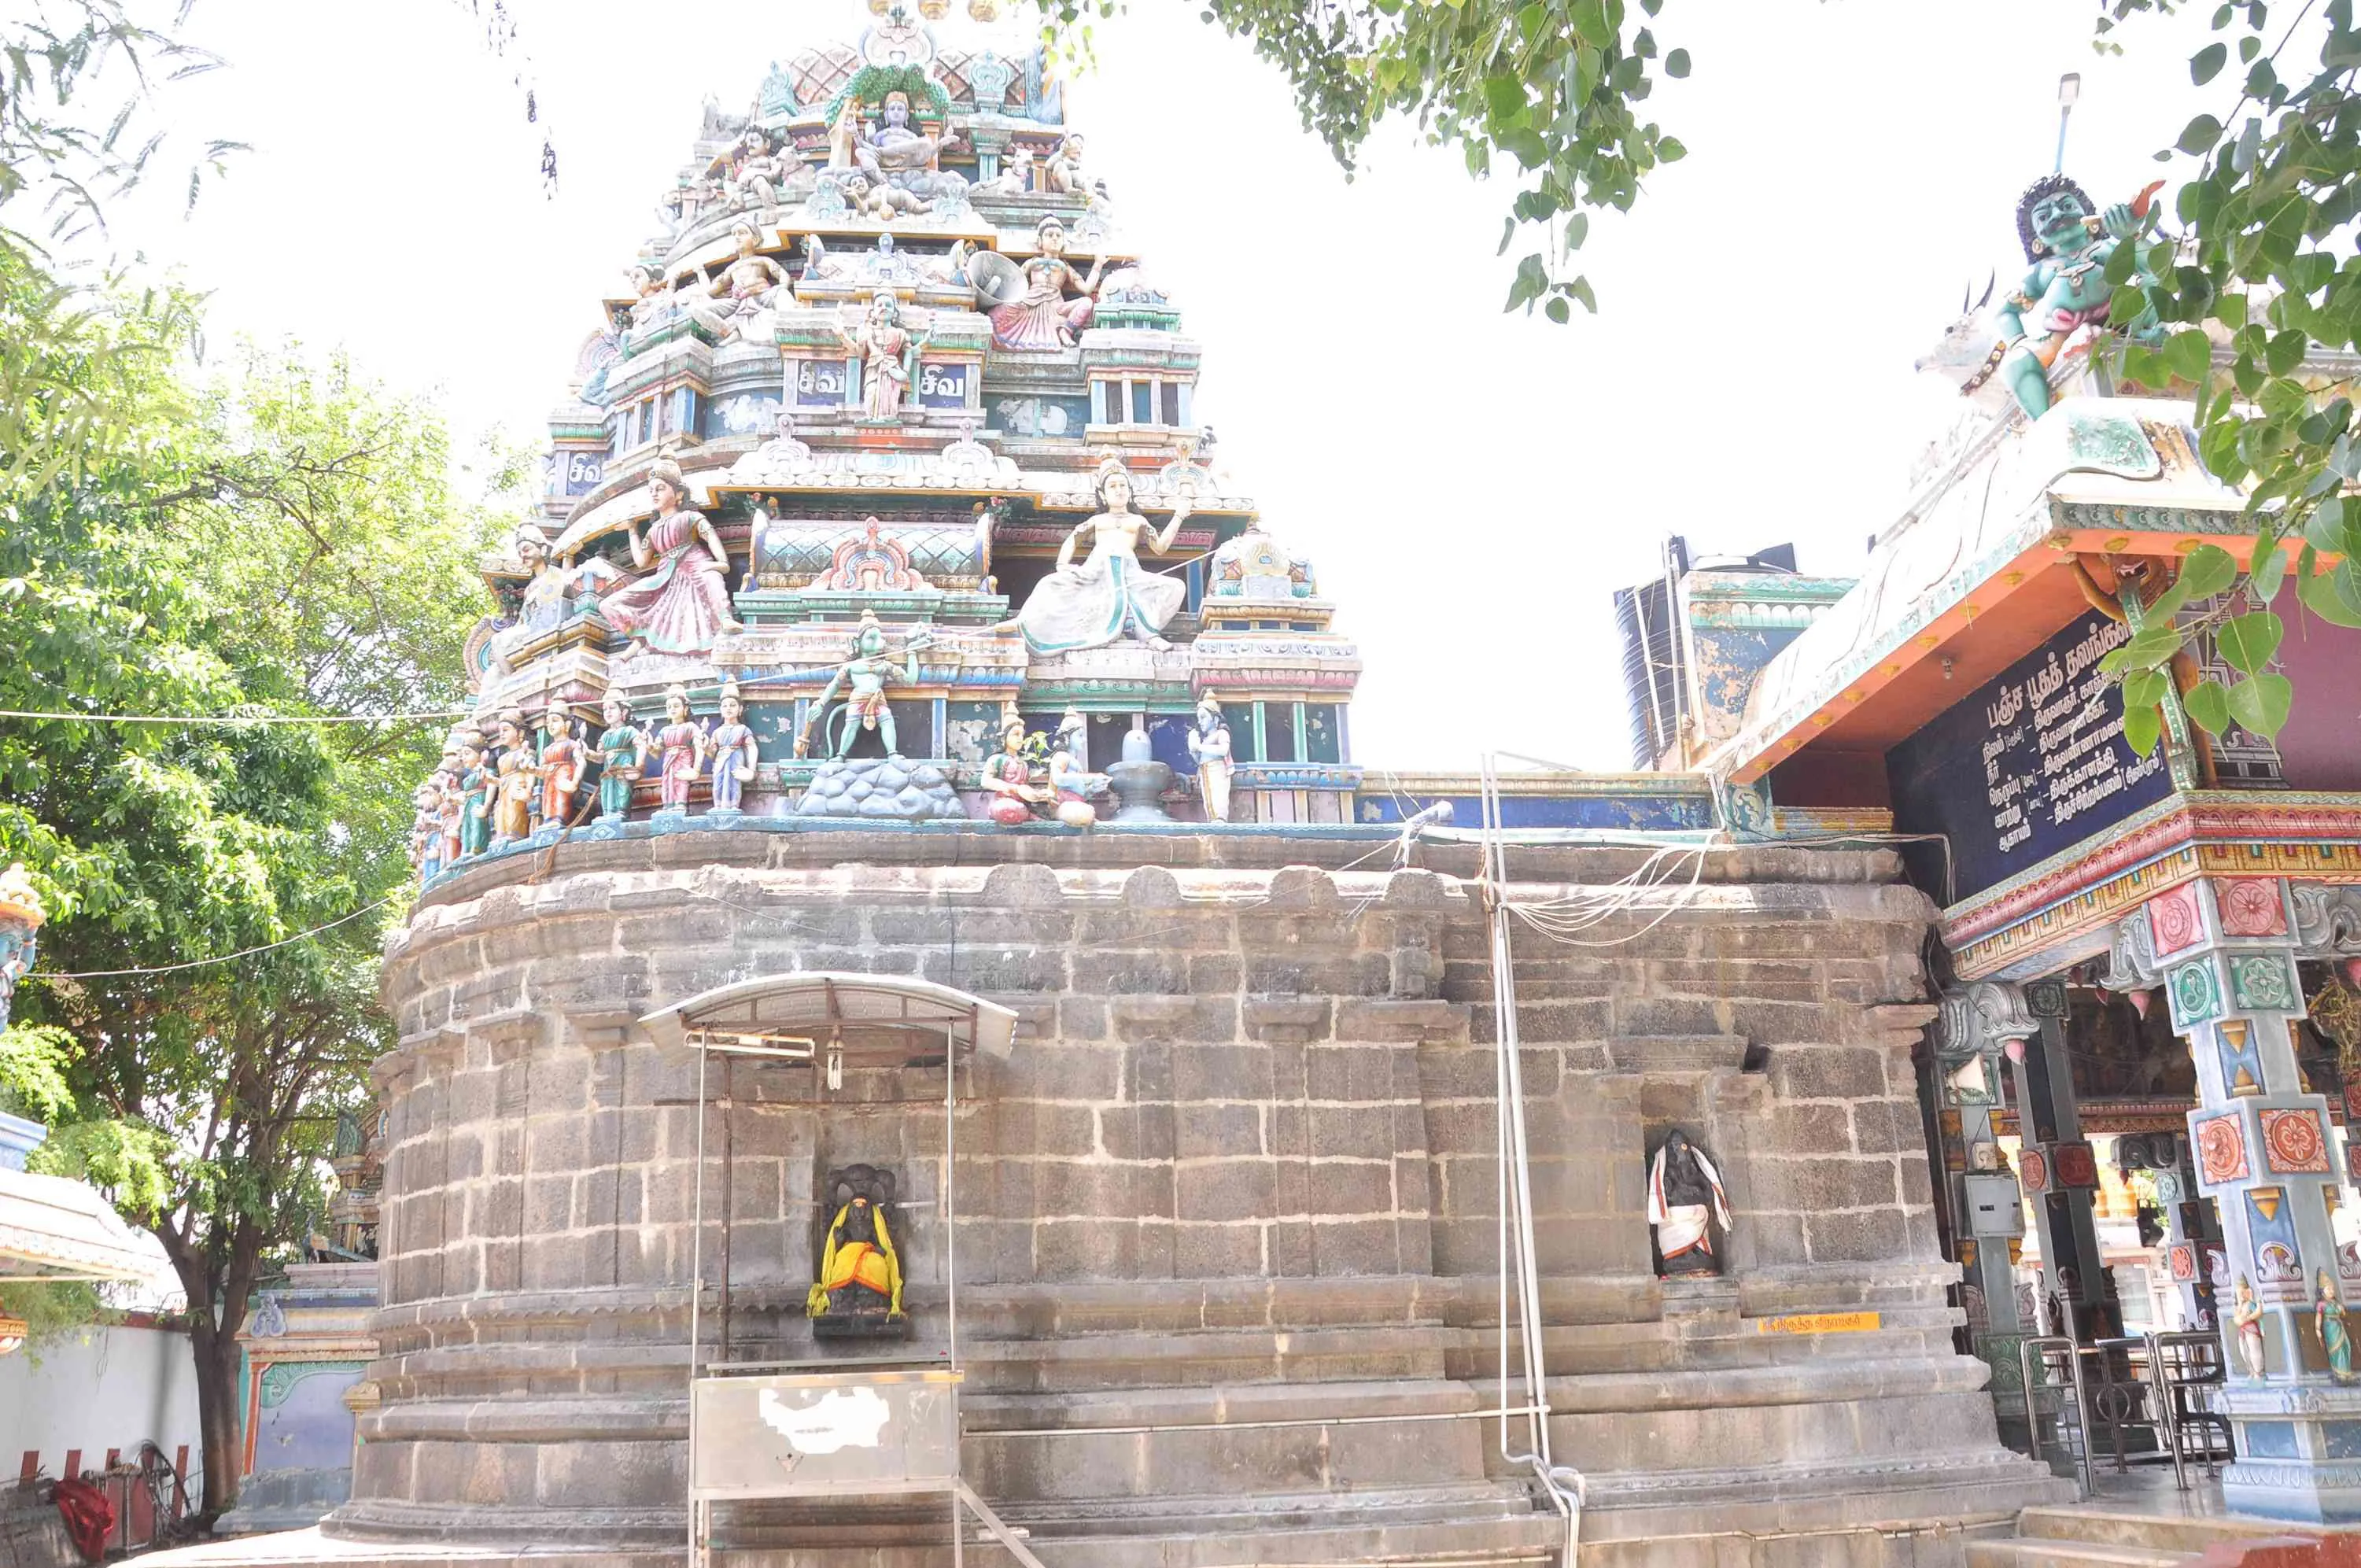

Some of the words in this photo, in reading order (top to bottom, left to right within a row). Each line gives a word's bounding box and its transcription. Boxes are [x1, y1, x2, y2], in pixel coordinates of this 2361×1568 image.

[1987, 684, 2023, 729] பஞ்ச
[2027, 651, 2063, 709] பூதத்
[1983, 733, 2005, 765] நிலம்
